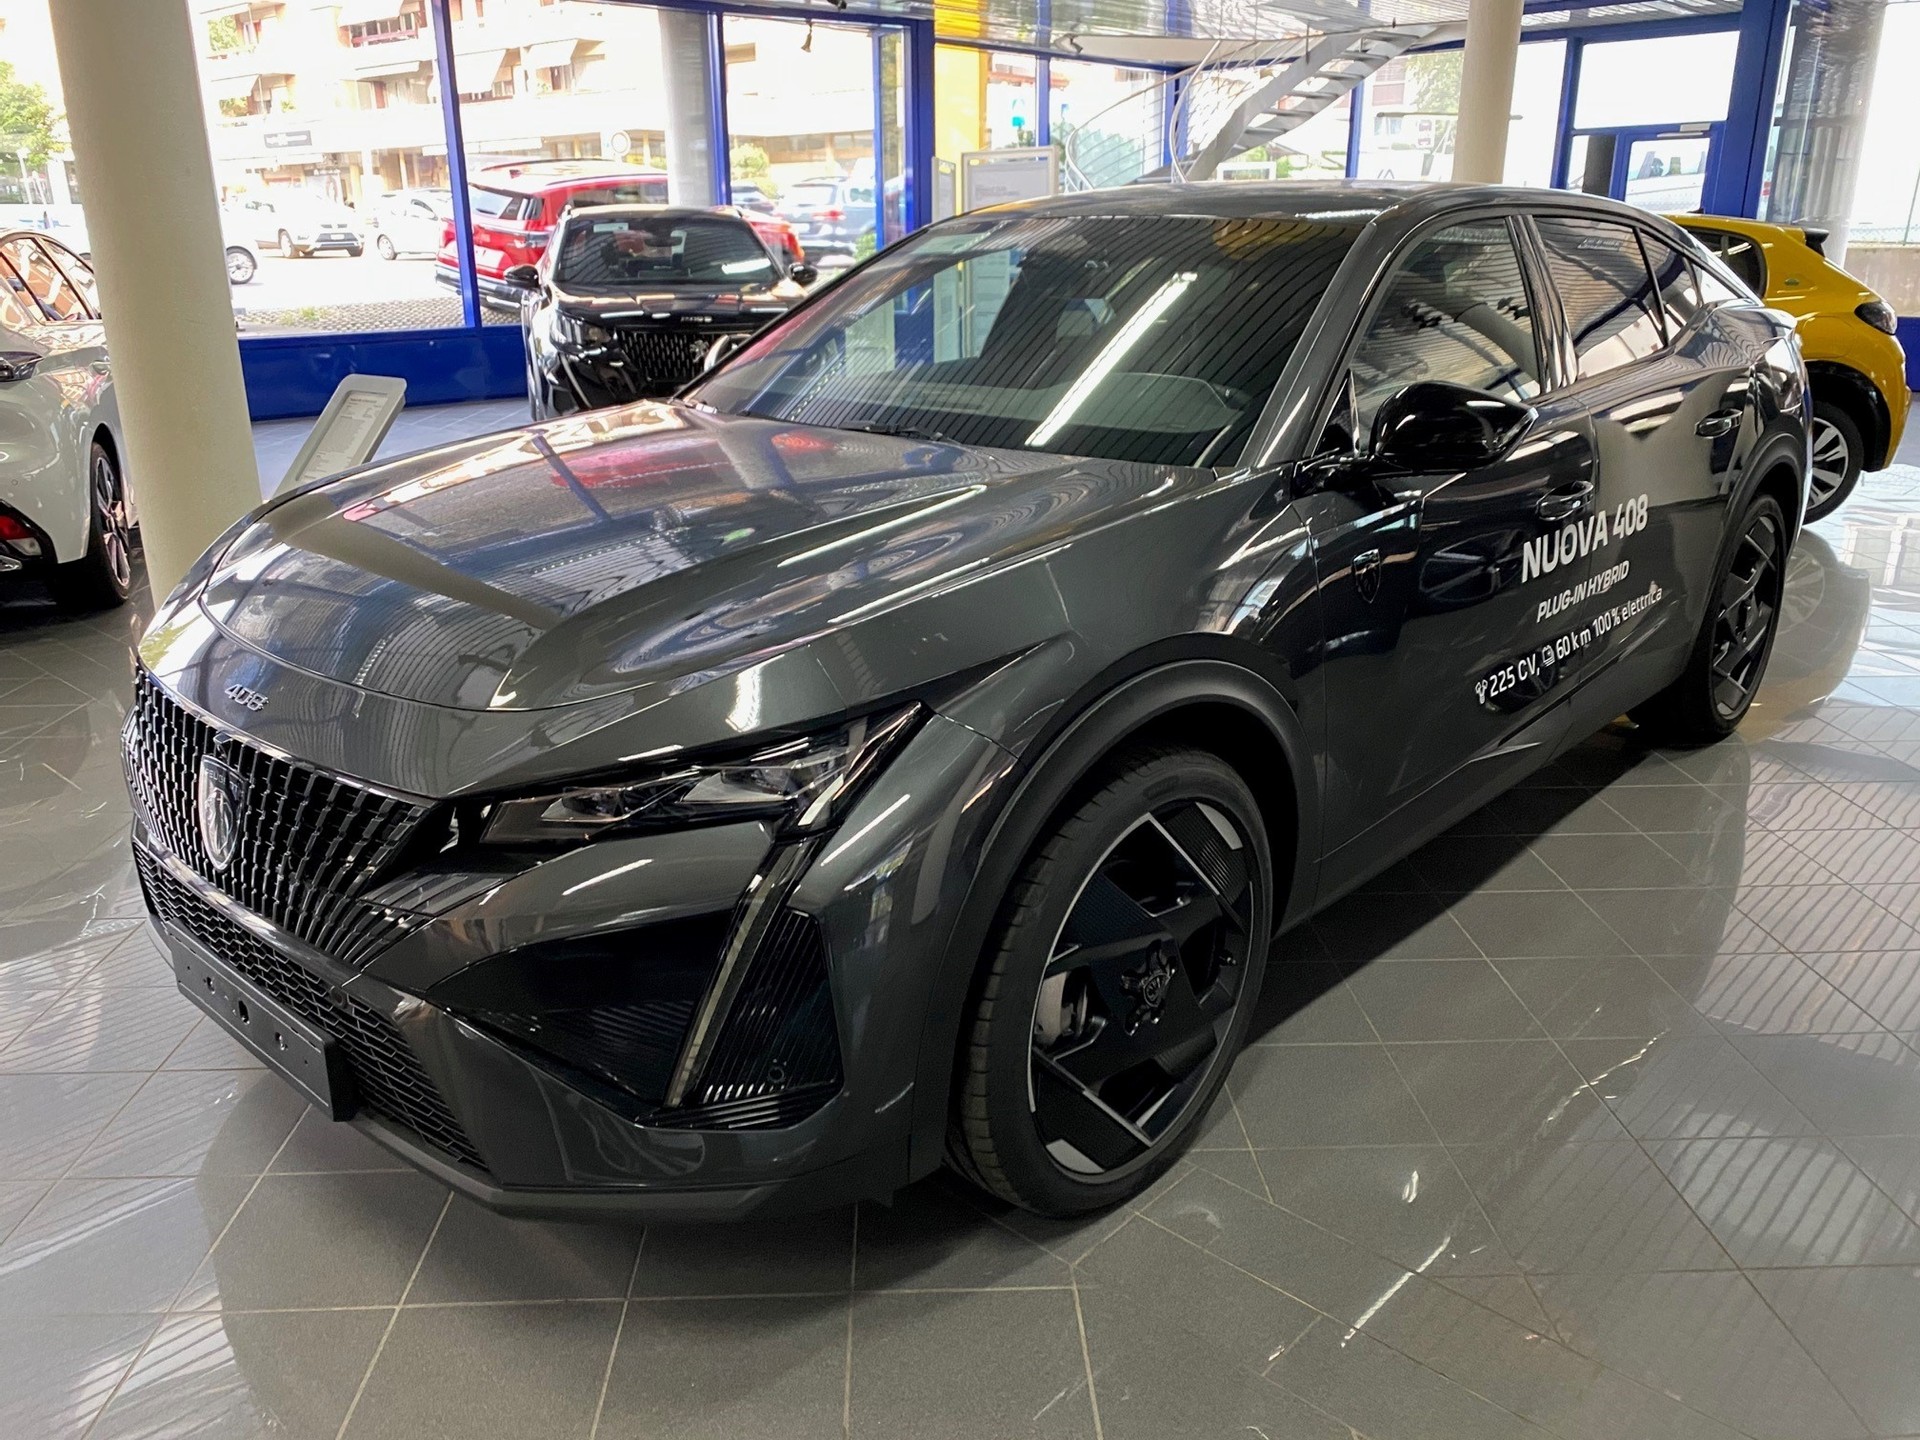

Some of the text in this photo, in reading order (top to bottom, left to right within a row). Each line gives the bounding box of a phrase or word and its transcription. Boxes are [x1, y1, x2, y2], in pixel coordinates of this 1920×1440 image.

[1522, 494, 1649, 584] NUOVA 408
[1536, 560, 1630, 623] PLUG-IN HYBRID
[1489, 666, 1516, 697] 225
[1517, 653, 1541, 681] CV,
[1555, 637, 1571, 660] 60
[1592, 607, 1621, 638] 100%
[1621, 587, 1663, 621] elettrica
[224, 683, 270, 711] 408
